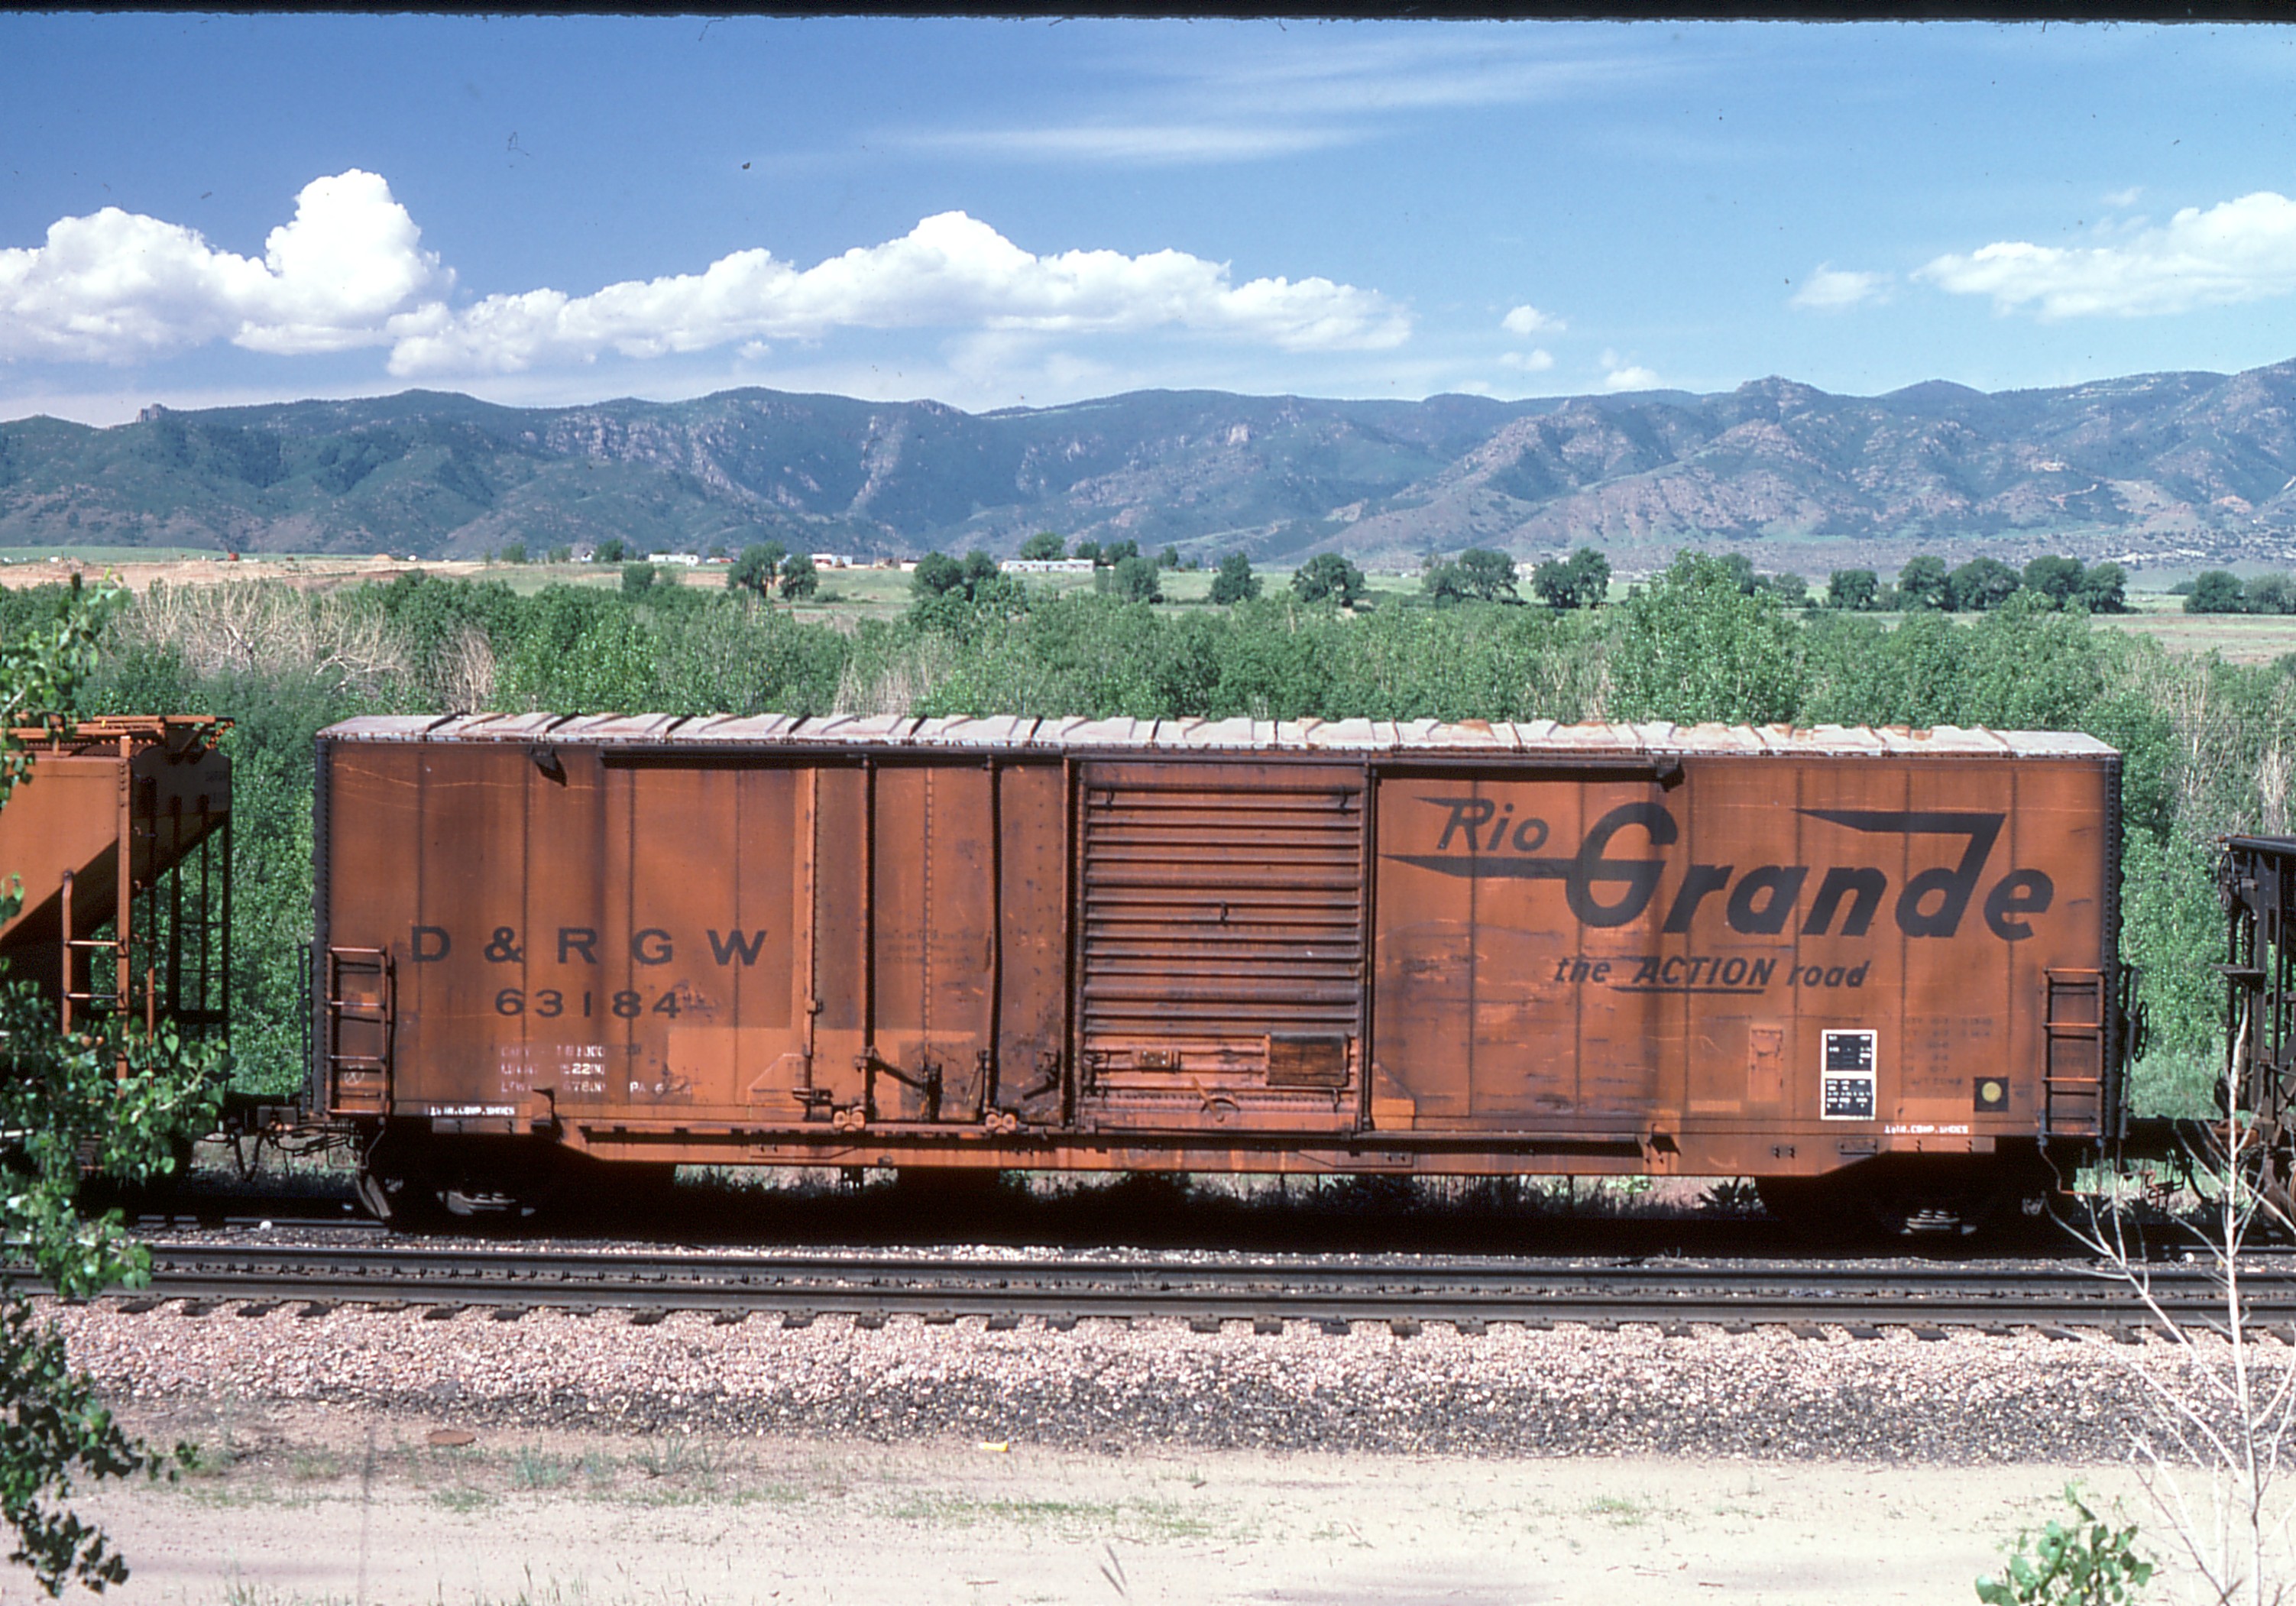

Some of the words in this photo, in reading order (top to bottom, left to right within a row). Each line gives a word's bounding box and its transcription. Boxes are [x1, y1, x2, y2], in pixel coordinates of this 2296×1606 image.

[1413, 796, 1550, 852] Rio
[1378, 799, 2055, 941] Grande
[1554, 956, 1611, 983] the
[1632, 954, 1777, 986] ACTION
[1786, 960, 1871, 988] road
[494, 988, 682, 1020] 63184
